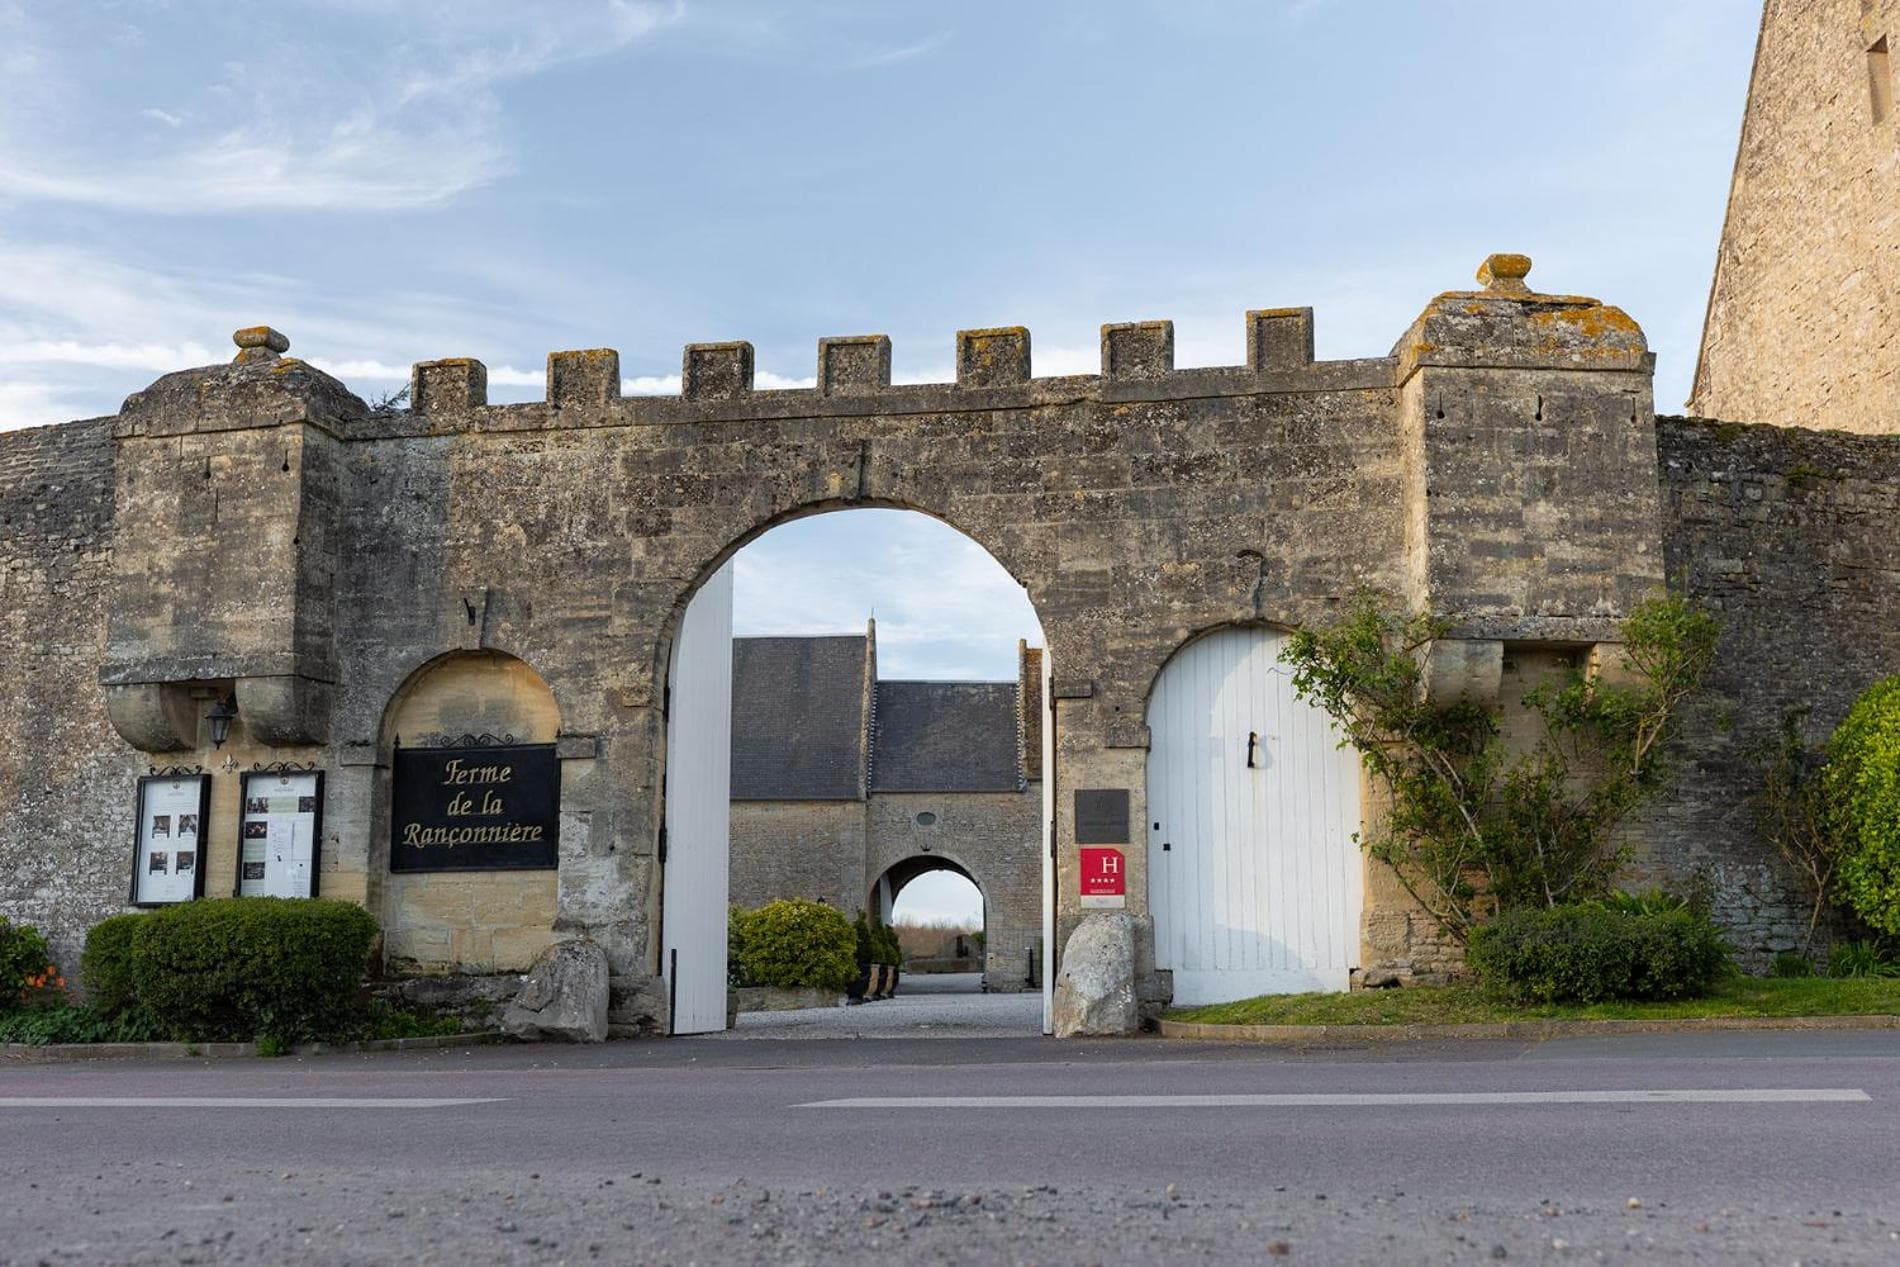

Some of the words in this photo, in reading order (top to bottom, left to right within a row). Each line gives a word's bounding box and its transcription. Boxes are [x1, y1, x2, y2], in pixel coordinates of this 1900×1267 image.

[442, 759, 512, 785] Ferme
[447, 791, 472, 816] de
[482, 790, 504, 815] la
[402, 823, 543, 849] Rançonnière
[1102, 856, 1118, 873] H
